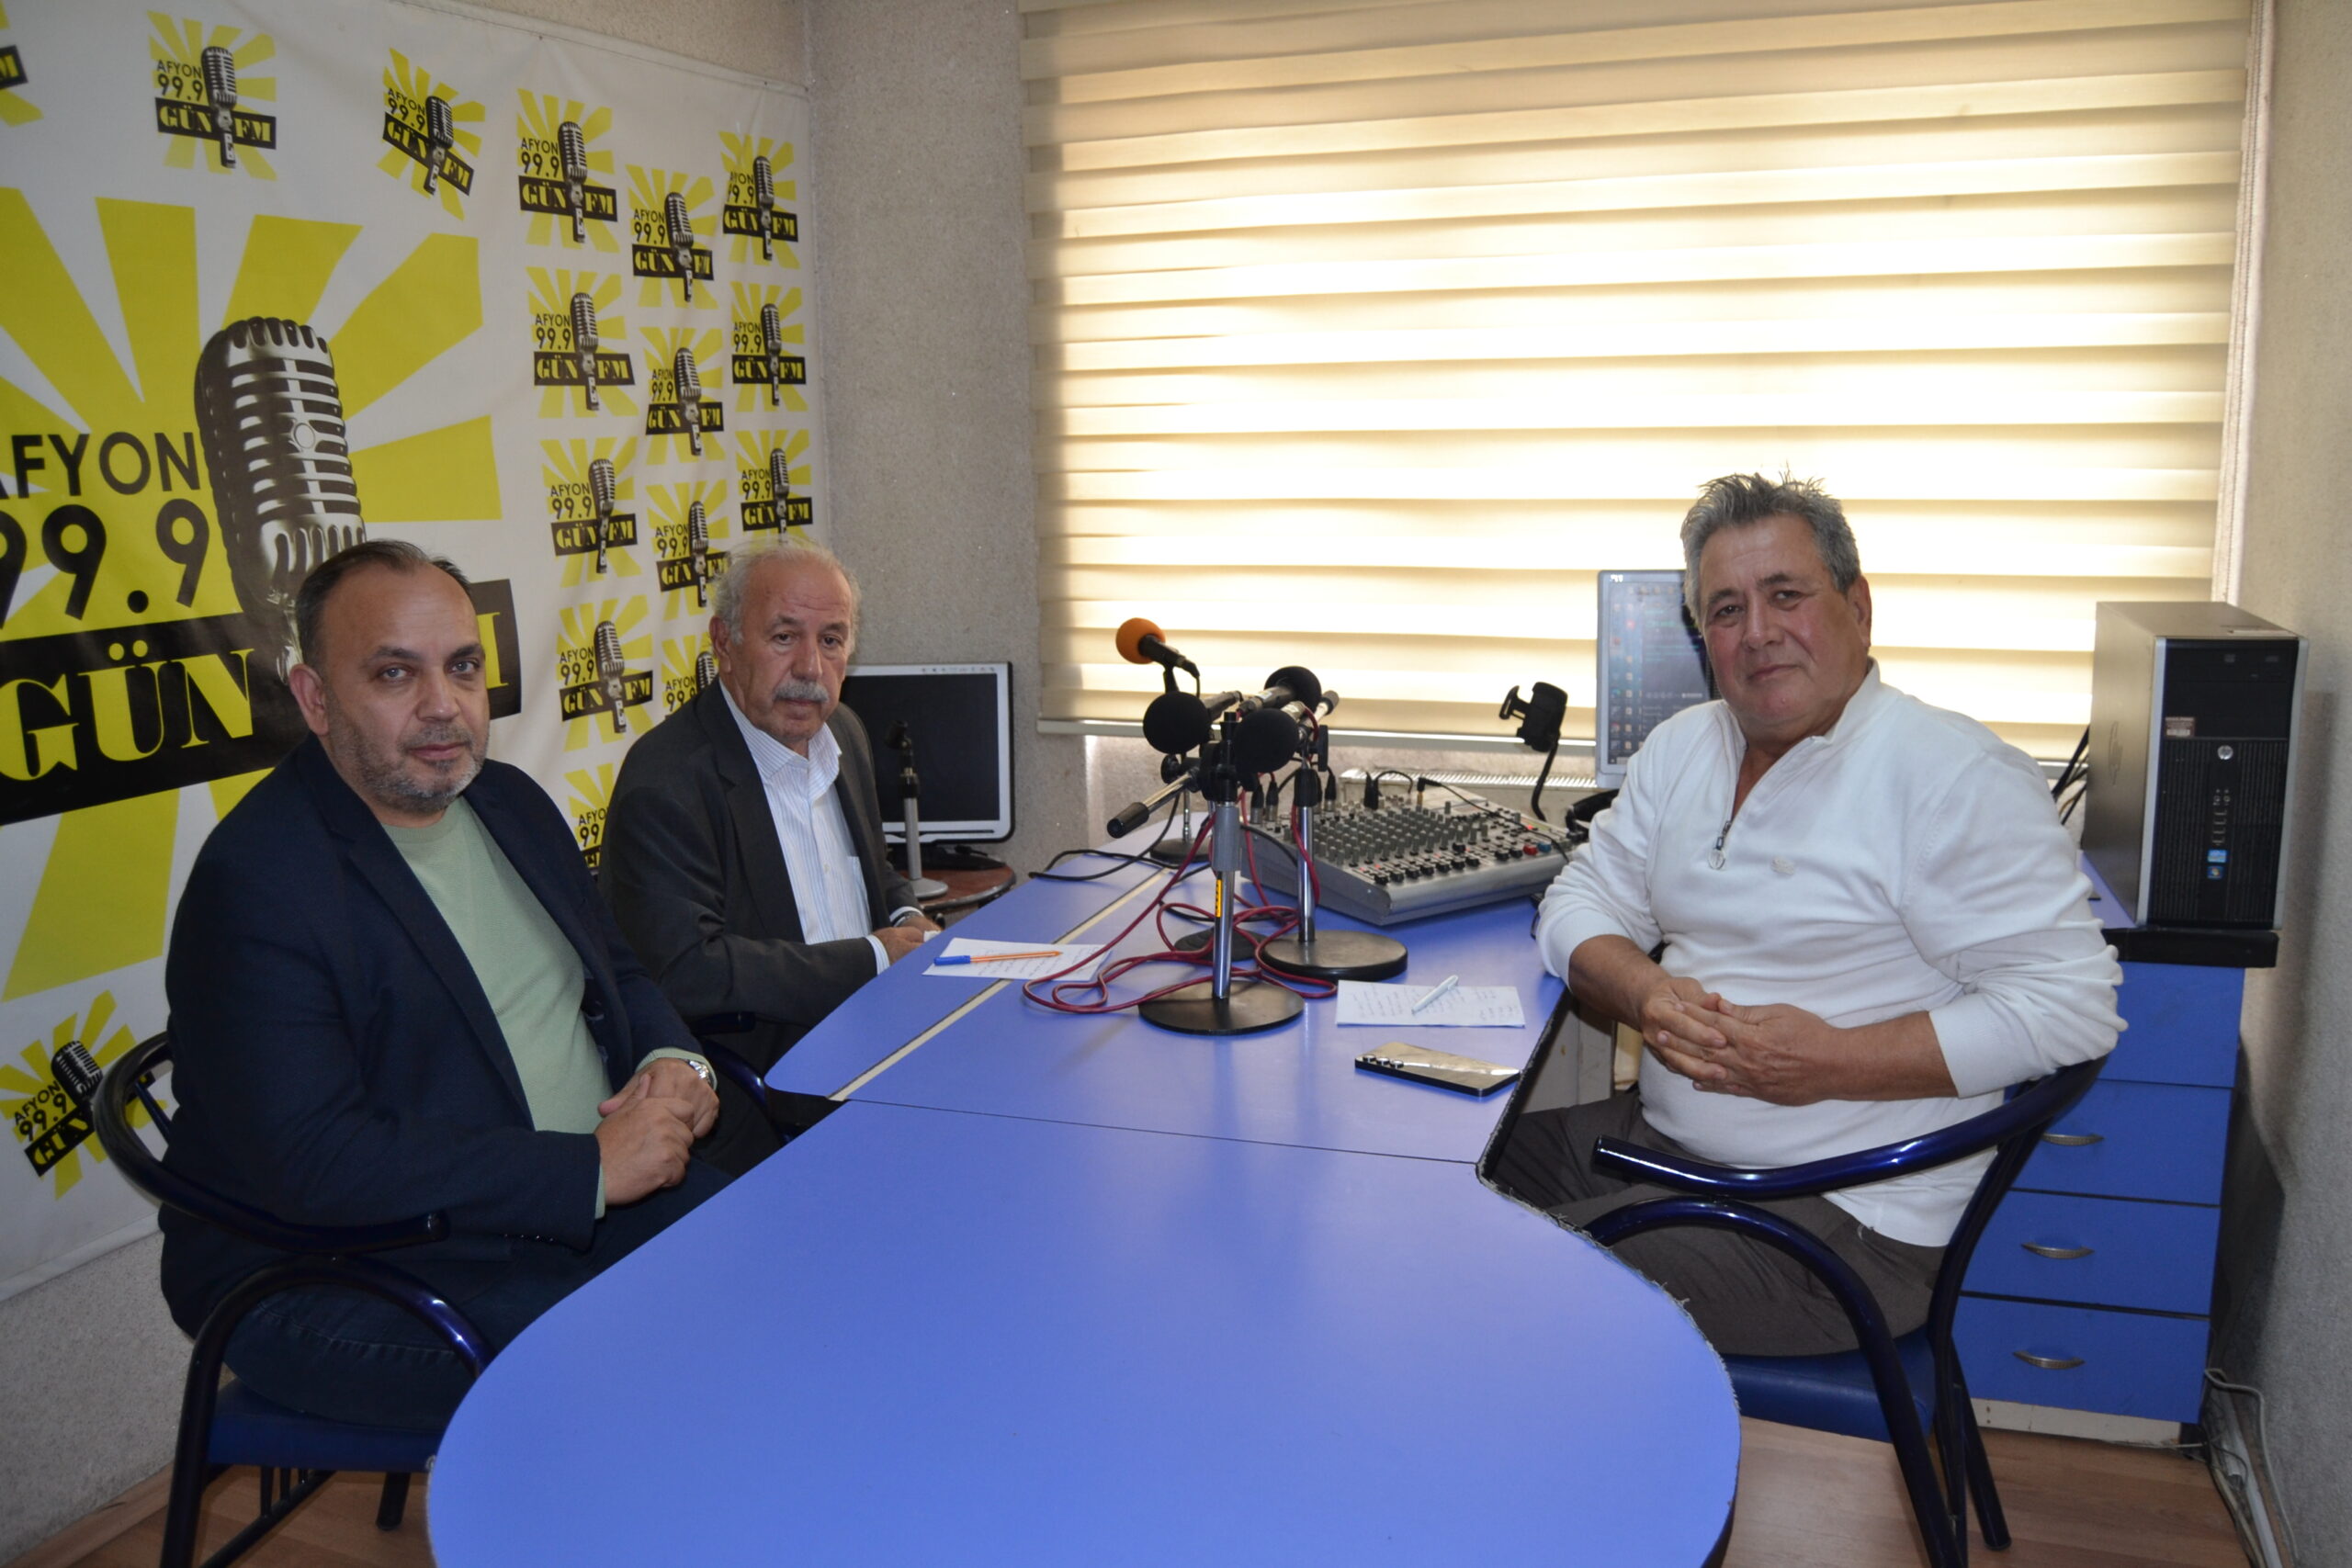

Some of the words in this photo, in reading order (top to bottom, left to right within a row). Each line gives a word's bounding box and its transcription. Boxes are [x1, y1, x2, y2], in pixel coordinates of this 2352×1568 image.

[156, 59, 202, 79] AFYON
[157, 73, 203, 101] 99.9
[388, 87, 425, 116] AFYON
[159, 105, 212, 133] GÜN
[233, 117, 272, 142] FM
[388, 97, 425, 131] 99.9
[521, 138, 559, 153] AFYON
[442, 157, 470, 187] FM
[521, 152, 560, 177] 99.9
[522, 183, 566, 209] GÜN
[585, 195, 614, 215] FM
[634, 209, 665, 223] AFYON
[724, 209, 759, 231] GÜN
[634, 220, 666, 244] 99.9
[635, 248, 674, 272] GÜN
[536, 313, 571, 327] AFYON
[733, 321, 762, 333] AFYON
[536, 327, 571, 349] 99.9
[733, 334, 762, 353] 99.9
[537, 355, 579, 378] GÜN
[596, 360, 630, 378] FM
[734, 356, 768, 378] GÜN
[780, 362, 802, 378] FM
[652, 381, 673, 401] 99.9
[649, 407, 681, 428] GÜN
[0, 432, 200, 500] FYON
[741, 468, 771, 481] AFYON
[550, 482, 591, 498] AFYON
[741, 480, 771, 500] 99.9
[551, 497, 593, 520] 99.9
[743, 503, 776, 525] GÜN
[788, 503, 809, 522] FM
[556, 523, 597, 549] GÜN
[608, 522, 637, 541] FM
[655, 525, 689, 538] AFYON
[657, 536, 688, 558] 99.9
[560, 647, 594, 663] AFYON
[560, 659, 594, 685] 99.9
[666, 675, 695, 691] AFYON
[562, 687, 603, 714] GÜN
[626, 678, 650, 701] FM
[0, 639, 254, 781] GÜN
[579, 808, 606, 827] AFYO
[15, 1079, 60, 1125] AFYON
[19, 1093, 66, 1141] 99.9
